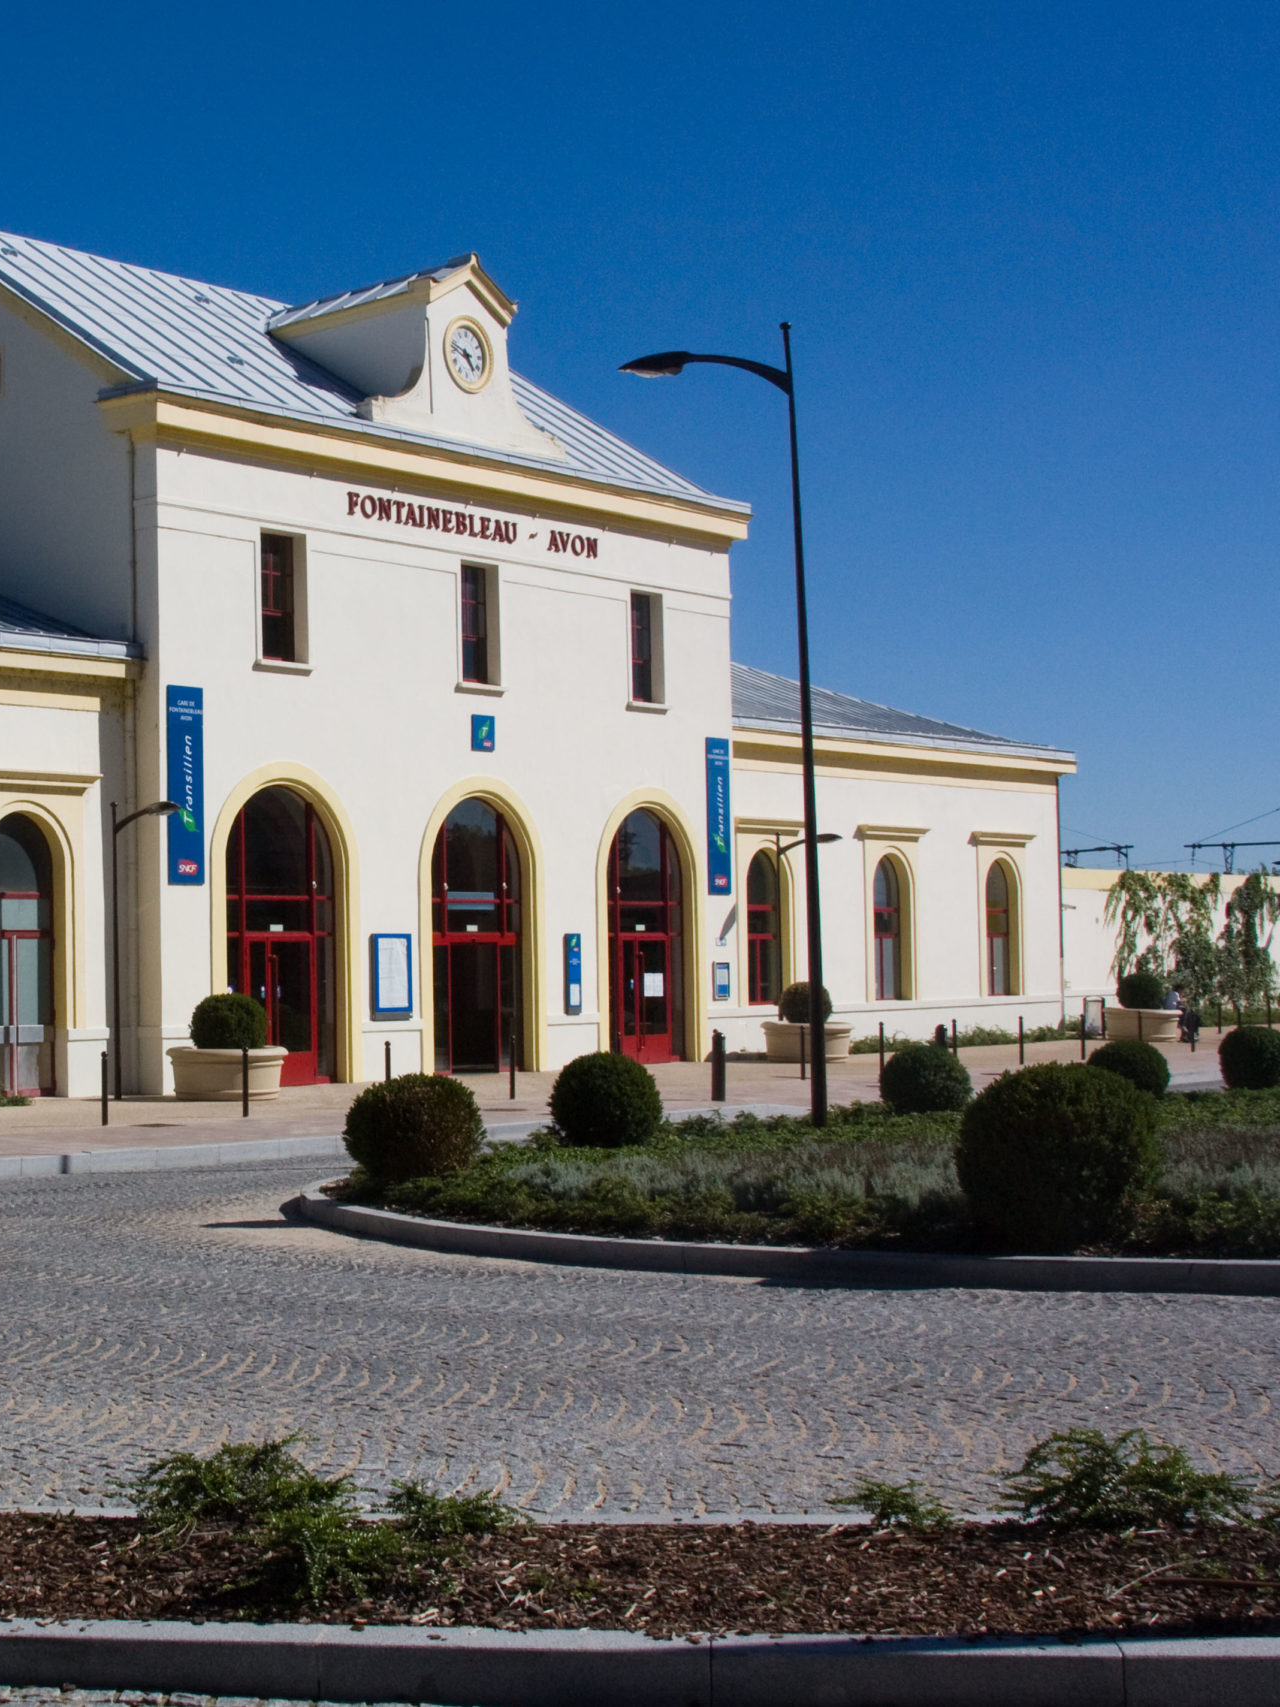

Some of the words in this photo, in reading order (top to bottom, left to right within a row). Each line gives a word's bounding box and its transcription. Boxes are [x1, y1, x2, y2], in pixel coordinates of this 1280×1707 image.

[346, 491, 518, 544] FONTAINEBLEAU
[547, 530, 599, 559] AVON
[183, 735, 193, 823] Transilien
[716, 776, 724, 847] Transilien
[178, 863, 198, 873] SNCF
